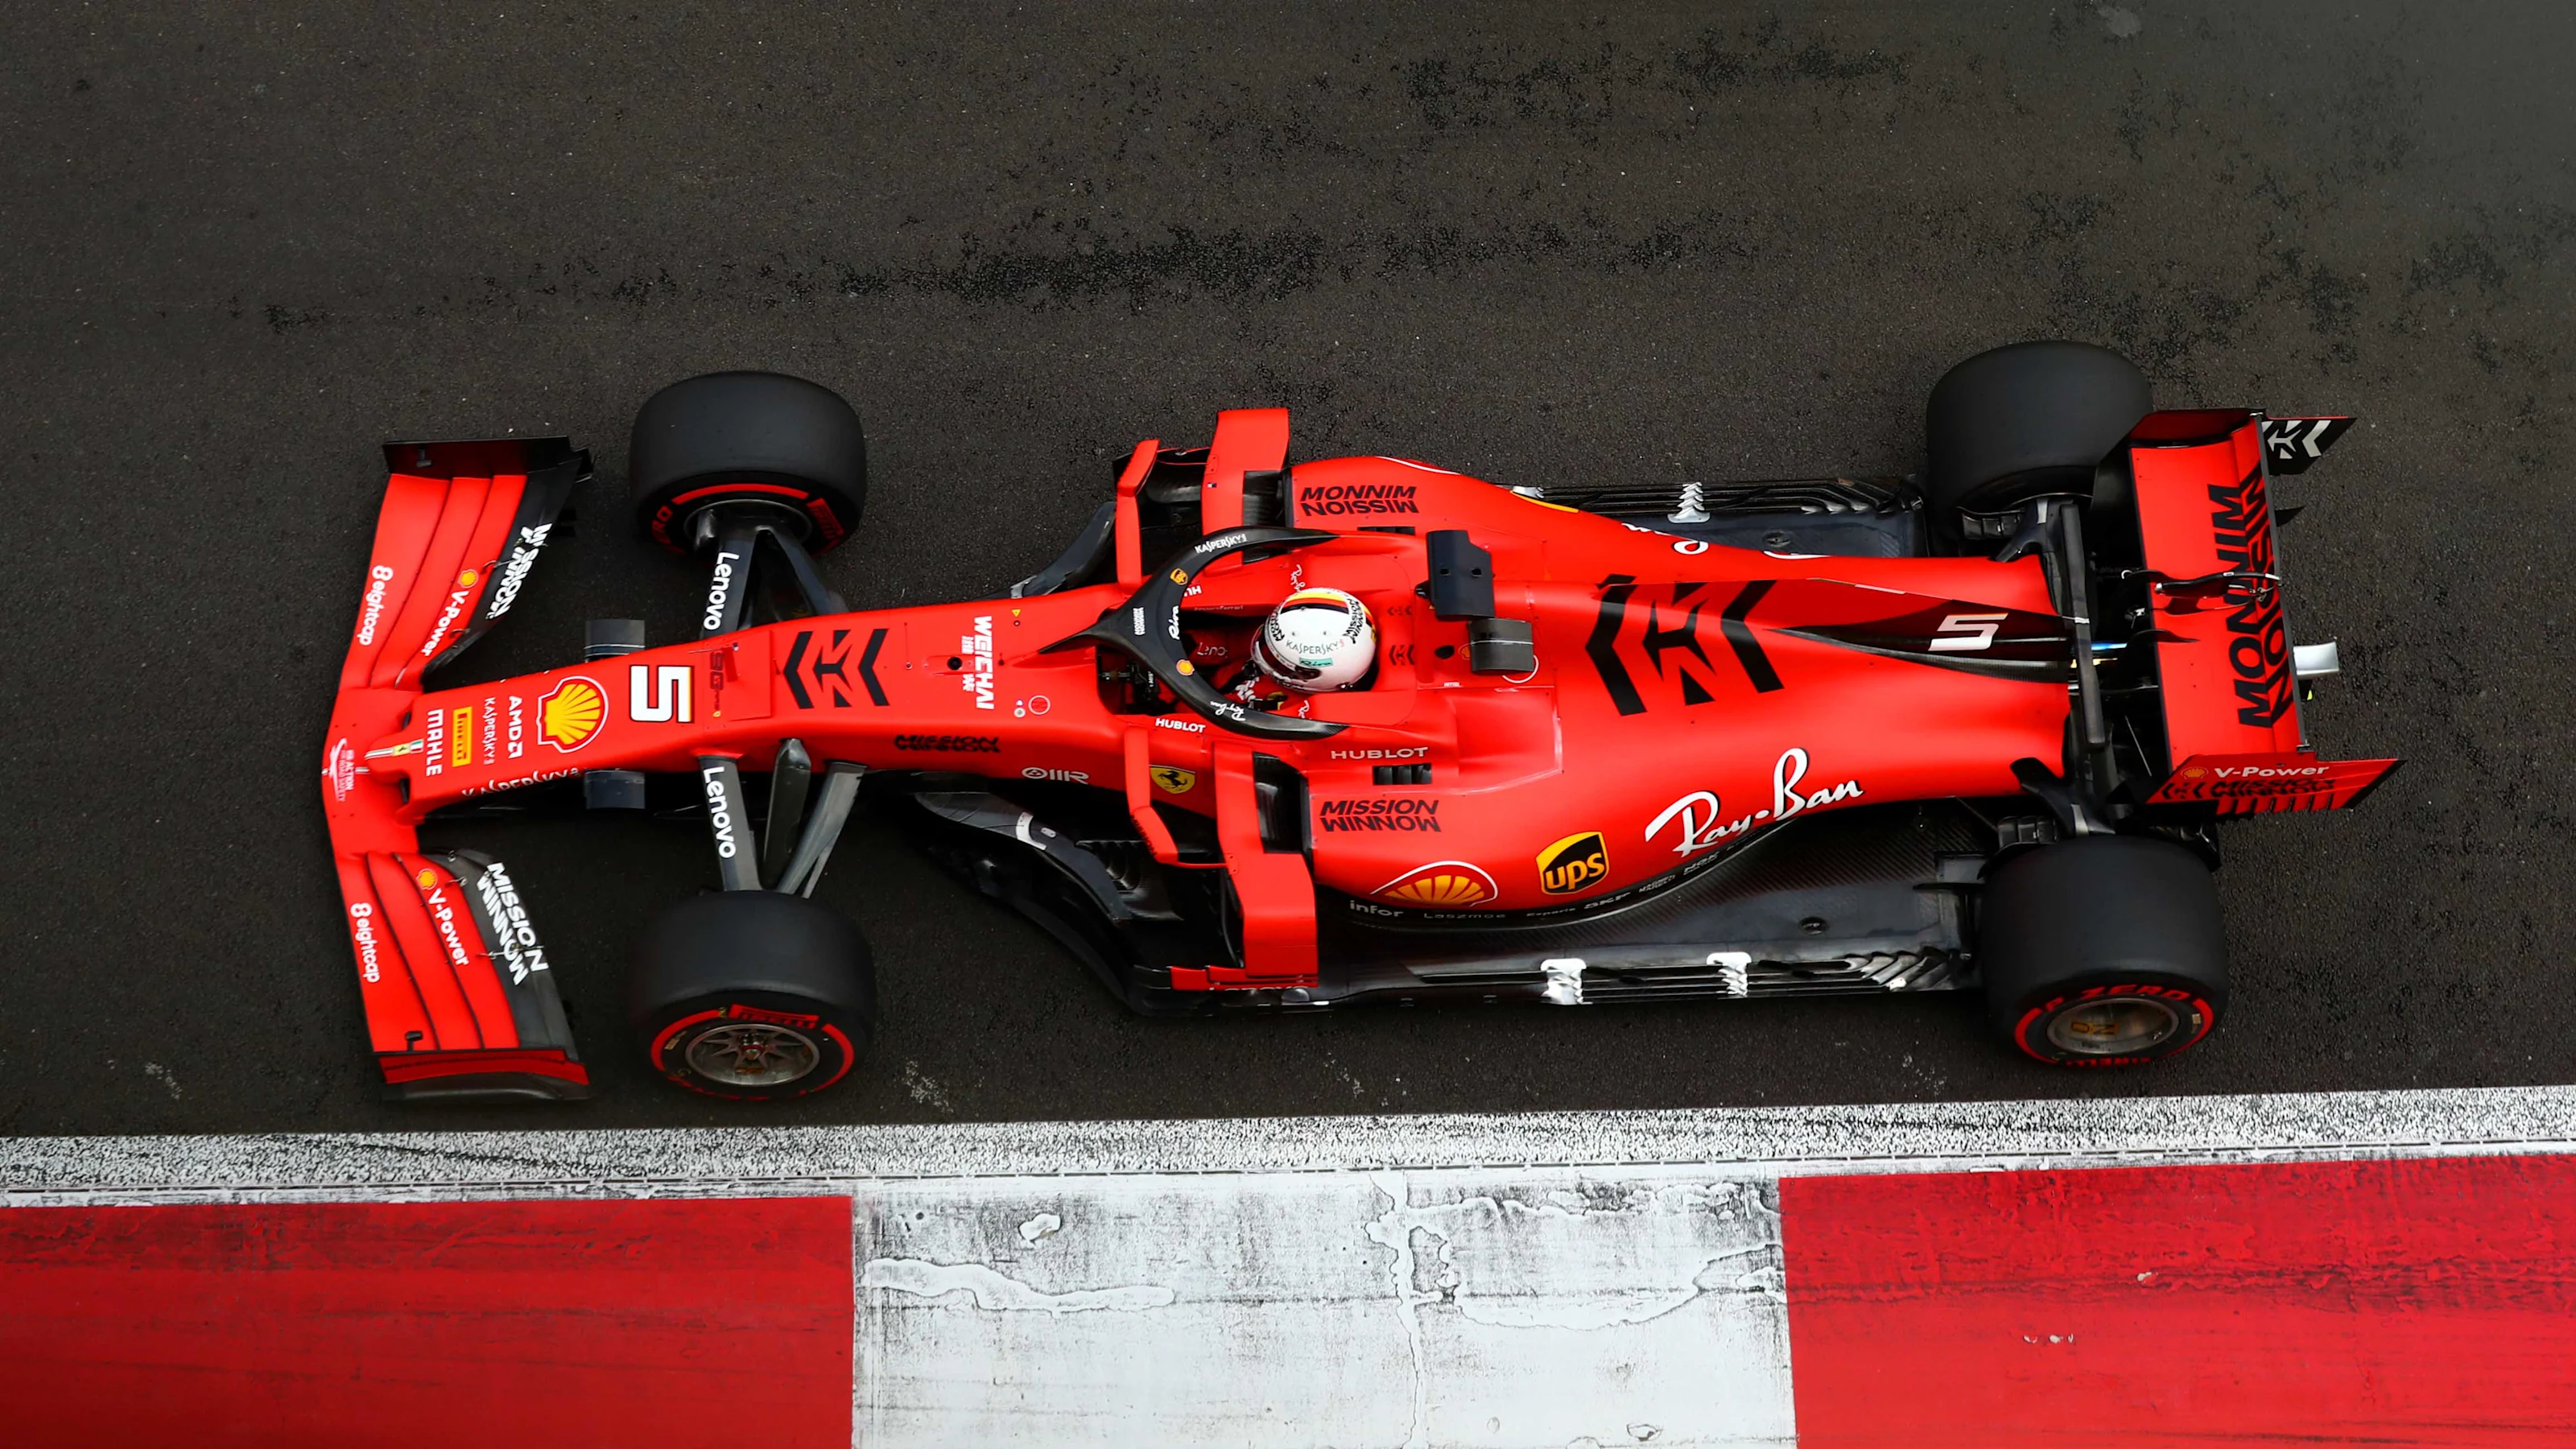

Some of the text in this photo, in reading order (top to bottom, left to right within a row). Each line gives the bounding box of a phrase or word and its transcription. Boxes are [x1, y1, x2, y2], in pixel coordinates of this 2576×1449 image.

[1300, 485, 1417, 501] WINNOW
[1300, 499, 1419, 516] MISSION
[1195, 535, 1242, 553] KASPERSKY
[703, 551, 740, 631] Lenovo
[421, 590, 469, 656] V-Power
[1168, 605, 1179, 640] Riva
[1928, 613, 2008, 651] 5
[974, 616, 995, 709] WEICHAI
[1286, 640, 1340, 654] KASPERSKY
[630, 665, 695, 723] 5
[482, 696, 498, 758] KASPERSKY
[508, 696, 523, 741] AMD
[1155, 717, 1206, 733] HUBLOT
[427, 708, 444, 777] MAHLE
[1330, 747, 1428, 760] HUBLOT
[2215, 766, 2330, 778] V-Power
[702, 766, 737, 859] Lenovo
[1319, 799, 1439, 816] MISSION
[1645, 748, 1865, 858] Ray-Ban
[1319, 815, 1442, 833] WINNOW
[1544, 852, 1606, 891] ups
[428, 888, 469, 967] V-Power
[486, 861, 549, 972] MISSION
[1349, 900, 1404, 918] infor
[477, 874, 530, 986] WINNOW
